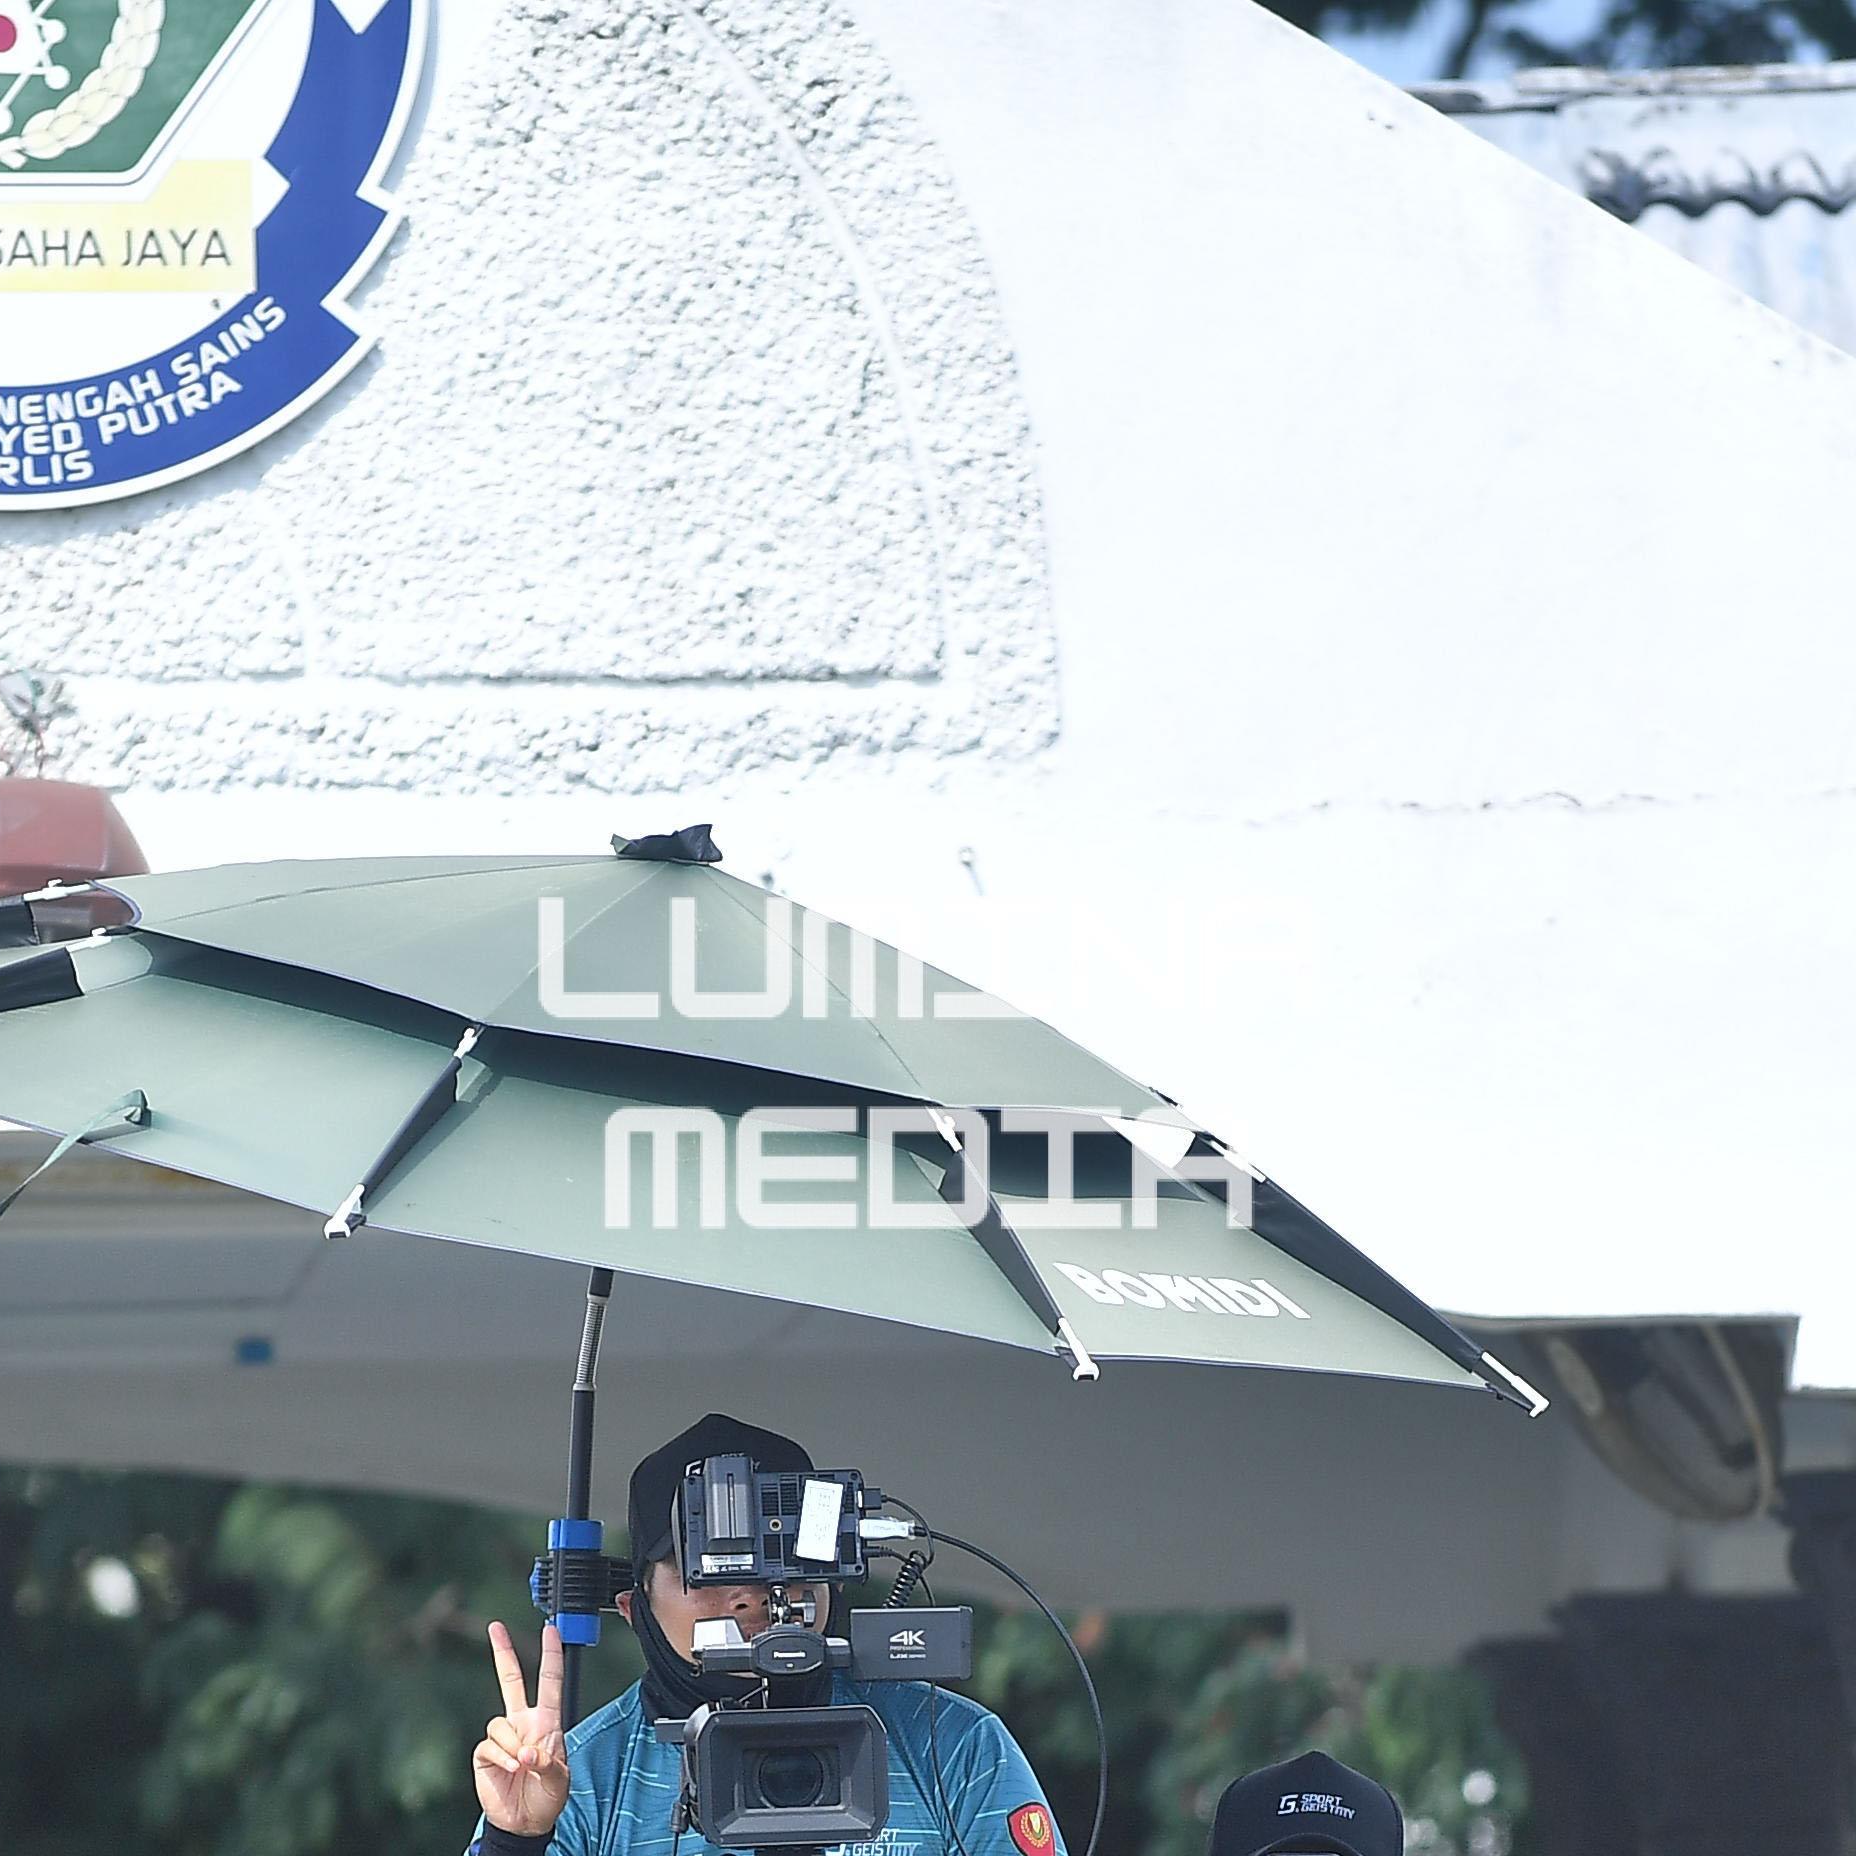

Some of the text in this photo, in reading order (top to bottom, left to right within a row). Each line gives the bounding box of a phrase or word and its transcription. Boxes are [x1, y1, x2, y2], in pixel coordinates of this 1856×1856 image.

[120, 227, 233, 269] JAYA
[176, 294, 289, 389] SAINS
[99, 368, 243, 449] PUTRA
[1052, 1262, 1312, 1320] BOMIDI
[889, 1629, 926, 1646] 4K
[1301, 1793, 1343, 1806] SPORT
